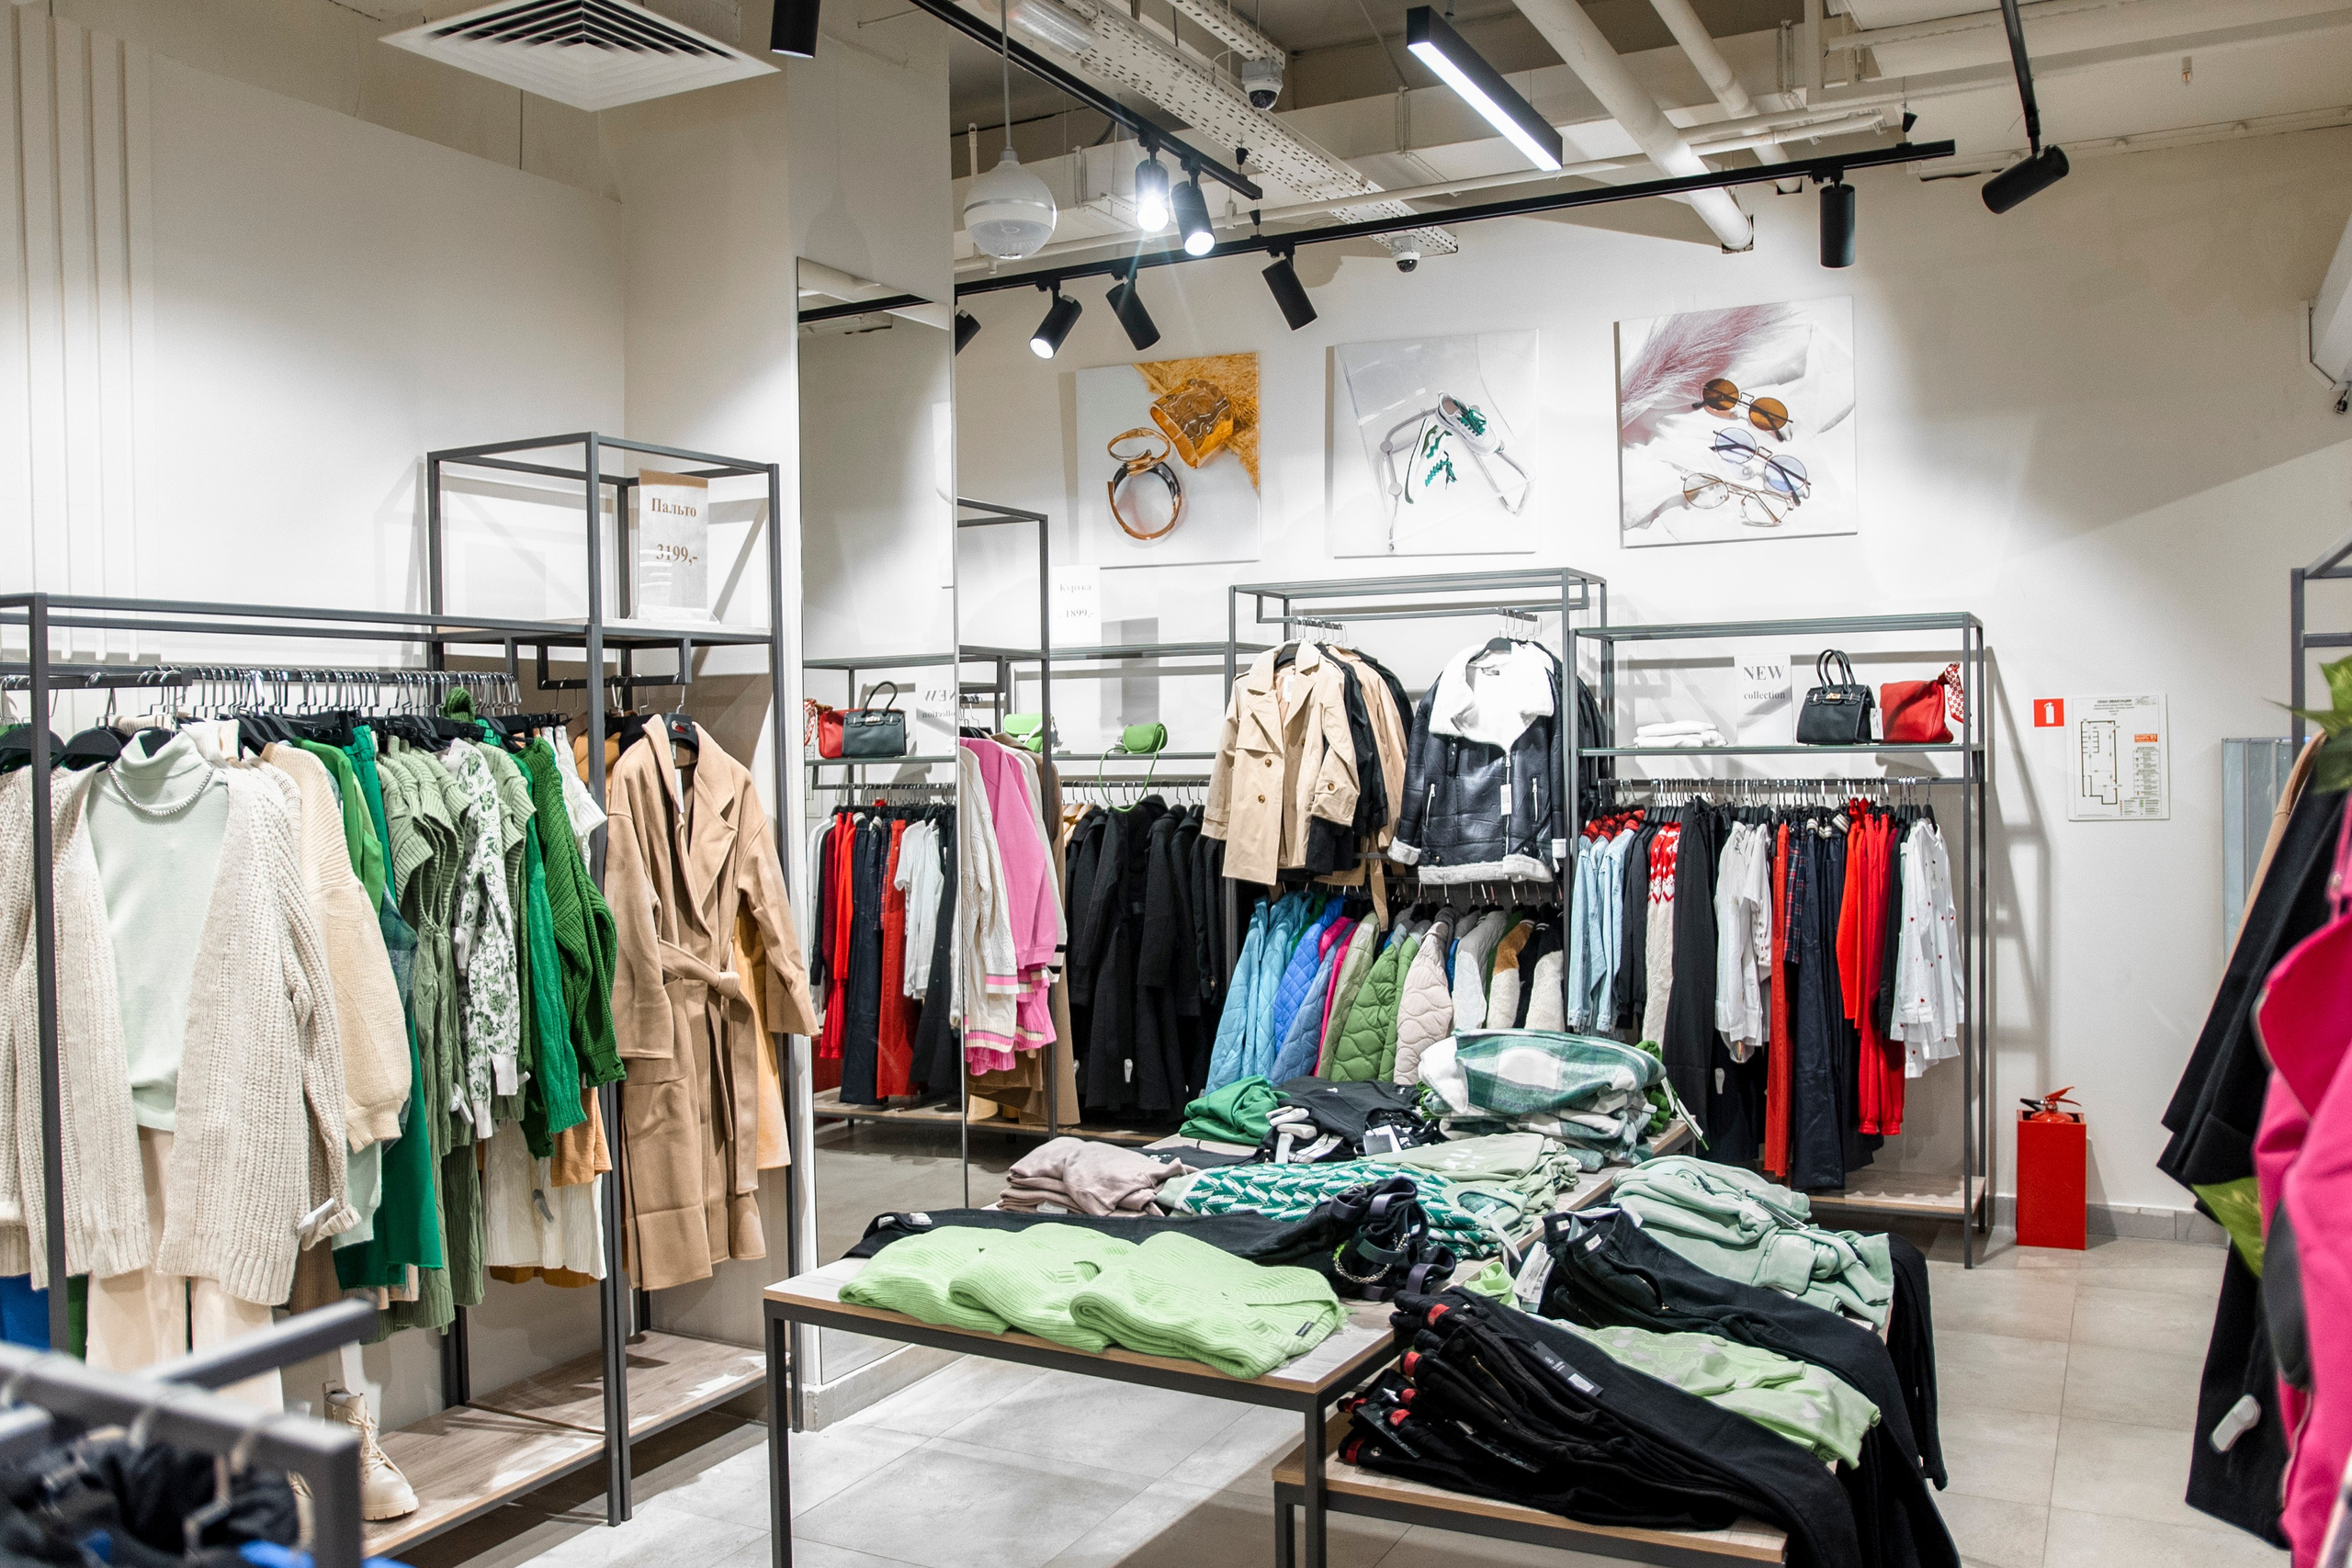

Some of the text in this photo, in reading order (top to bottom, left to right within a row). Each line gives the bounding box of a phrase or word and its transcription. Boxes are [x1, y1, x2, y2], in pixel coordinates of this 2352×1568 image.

[650, 497, 697, 517] Пальто
[656, 543, 698, 566] 3199,-
[1743, 665, 1784, 681] NEW
[1743, 690, 1786, 700] collection
